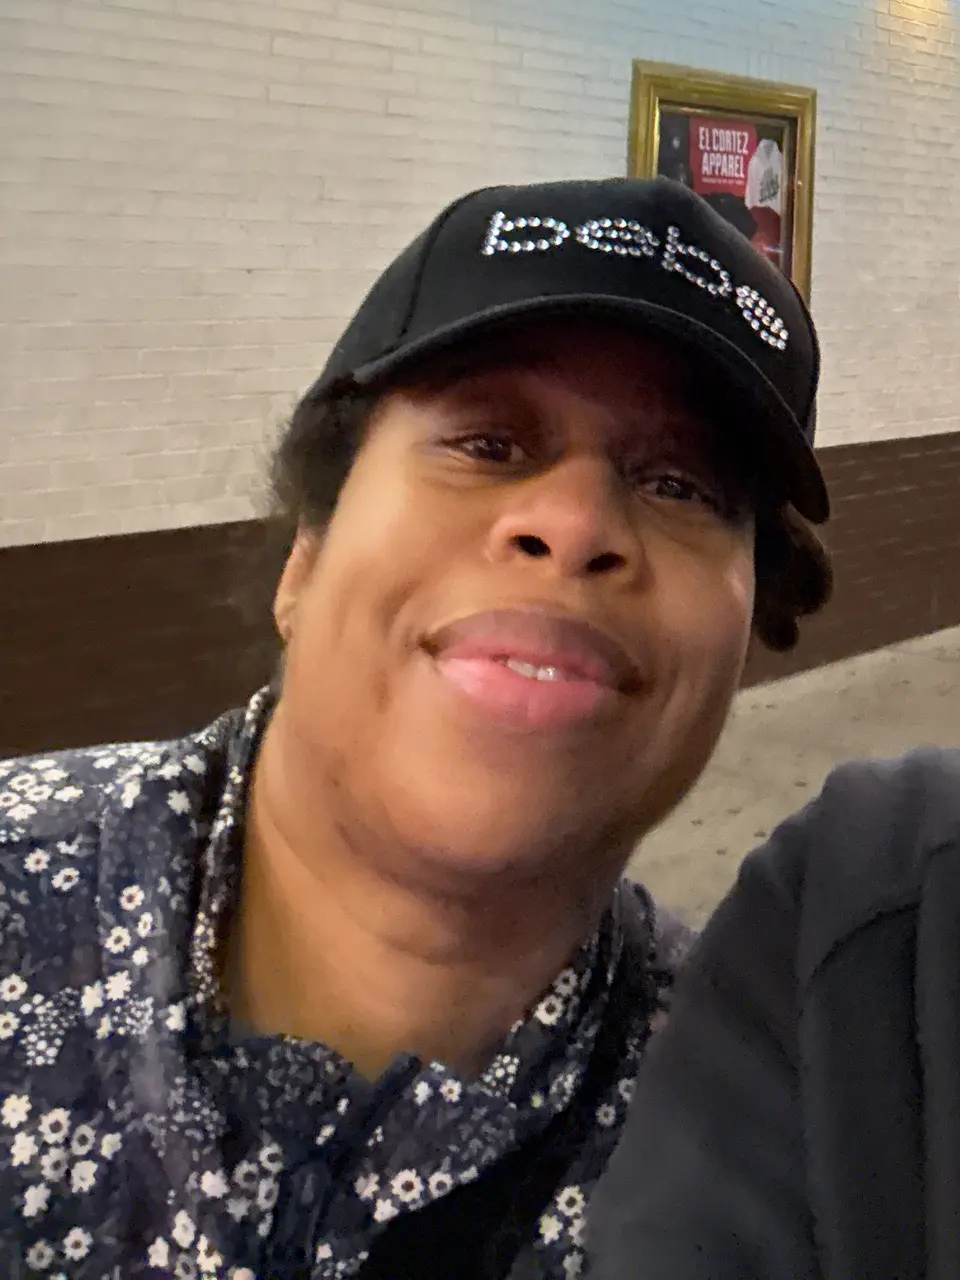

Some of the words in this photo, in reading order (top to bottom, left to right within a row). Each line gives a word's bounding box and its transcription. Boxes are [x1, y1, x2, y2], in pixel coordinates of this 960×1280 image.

[698, 126, 711, 151] EL
[712, 127, 749, 155] CORTEZ
[701, 151, 745, 178] APPAREL
[481, 211, 789, 350] bebe
